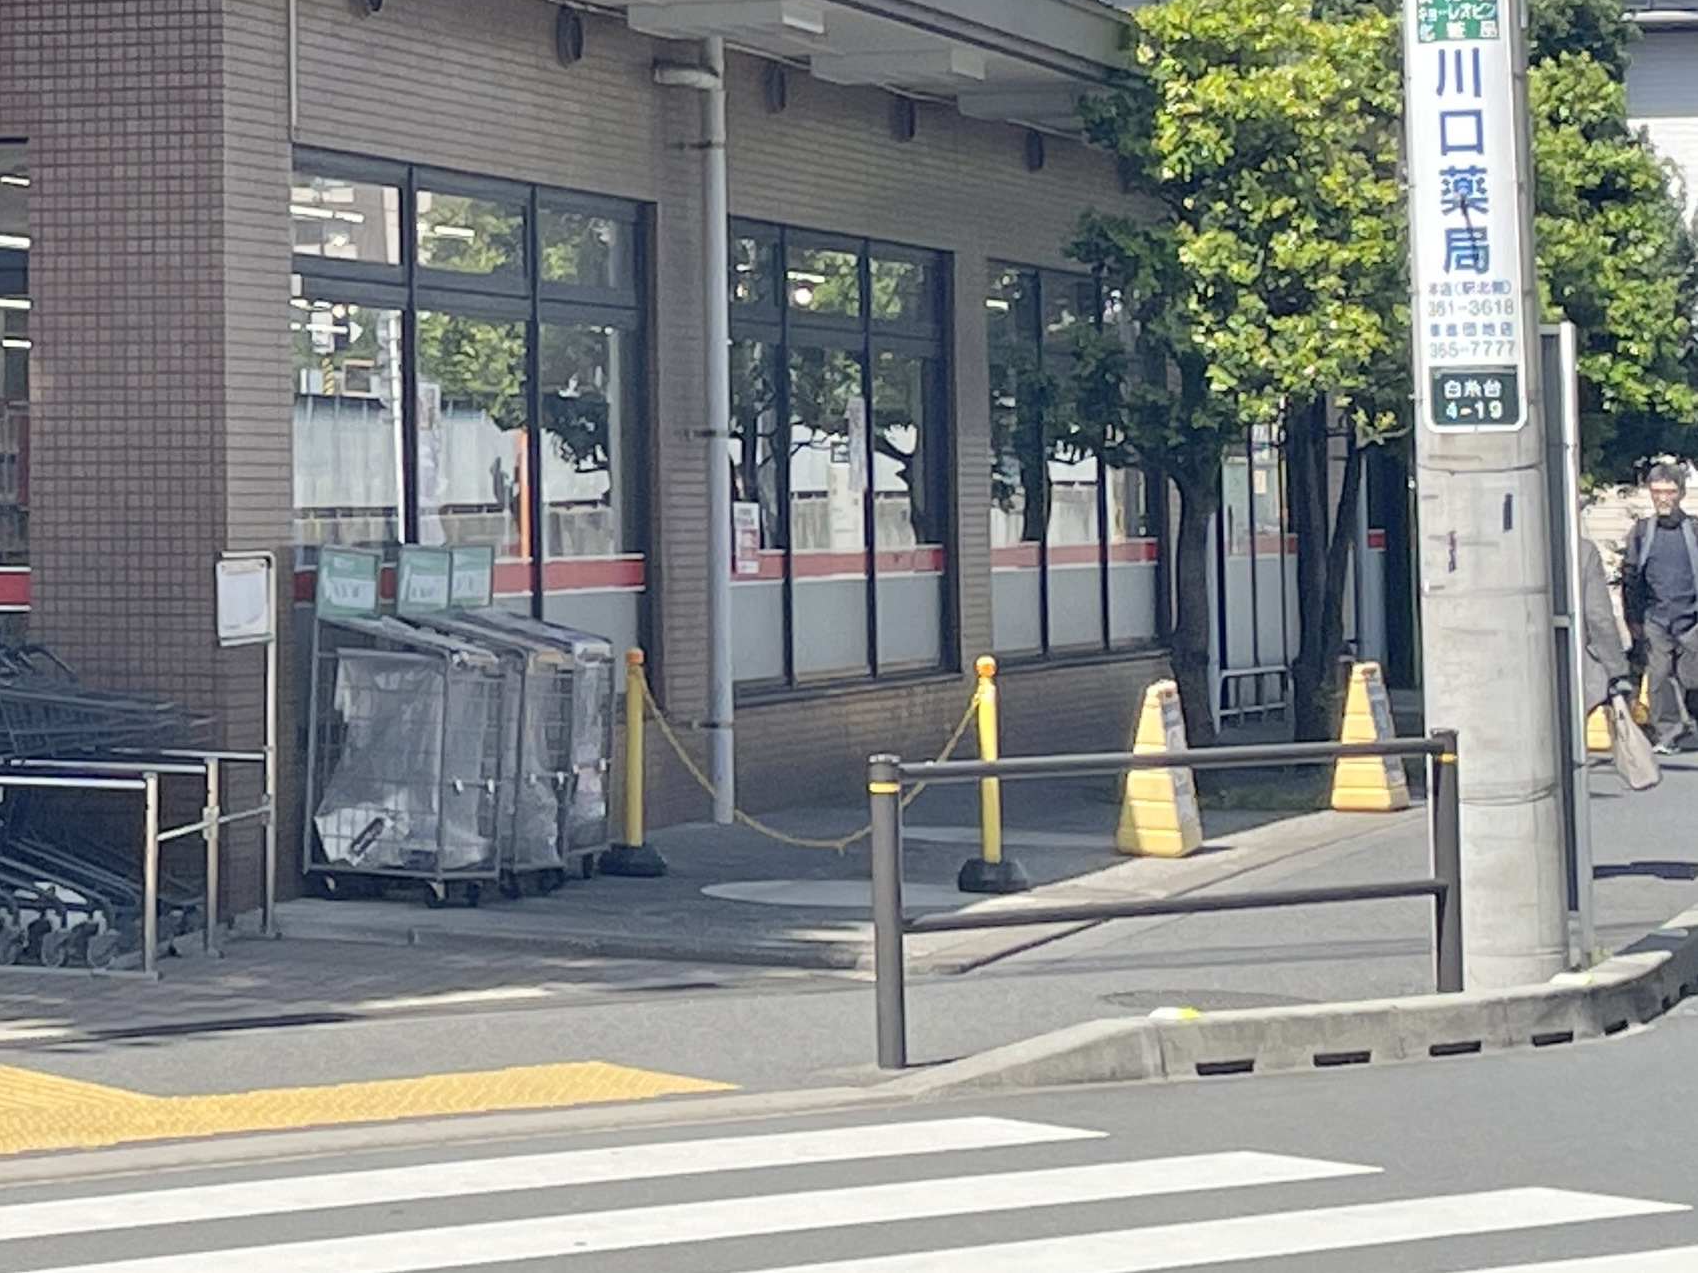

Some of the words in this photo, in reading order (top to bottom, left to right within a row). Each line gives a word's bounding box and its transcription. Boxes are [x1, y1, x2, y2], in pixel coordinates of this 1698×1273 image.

[1436, 47, 1491, 275] 川口薬局
[1443, 378, 1502, 400] 白糸台
